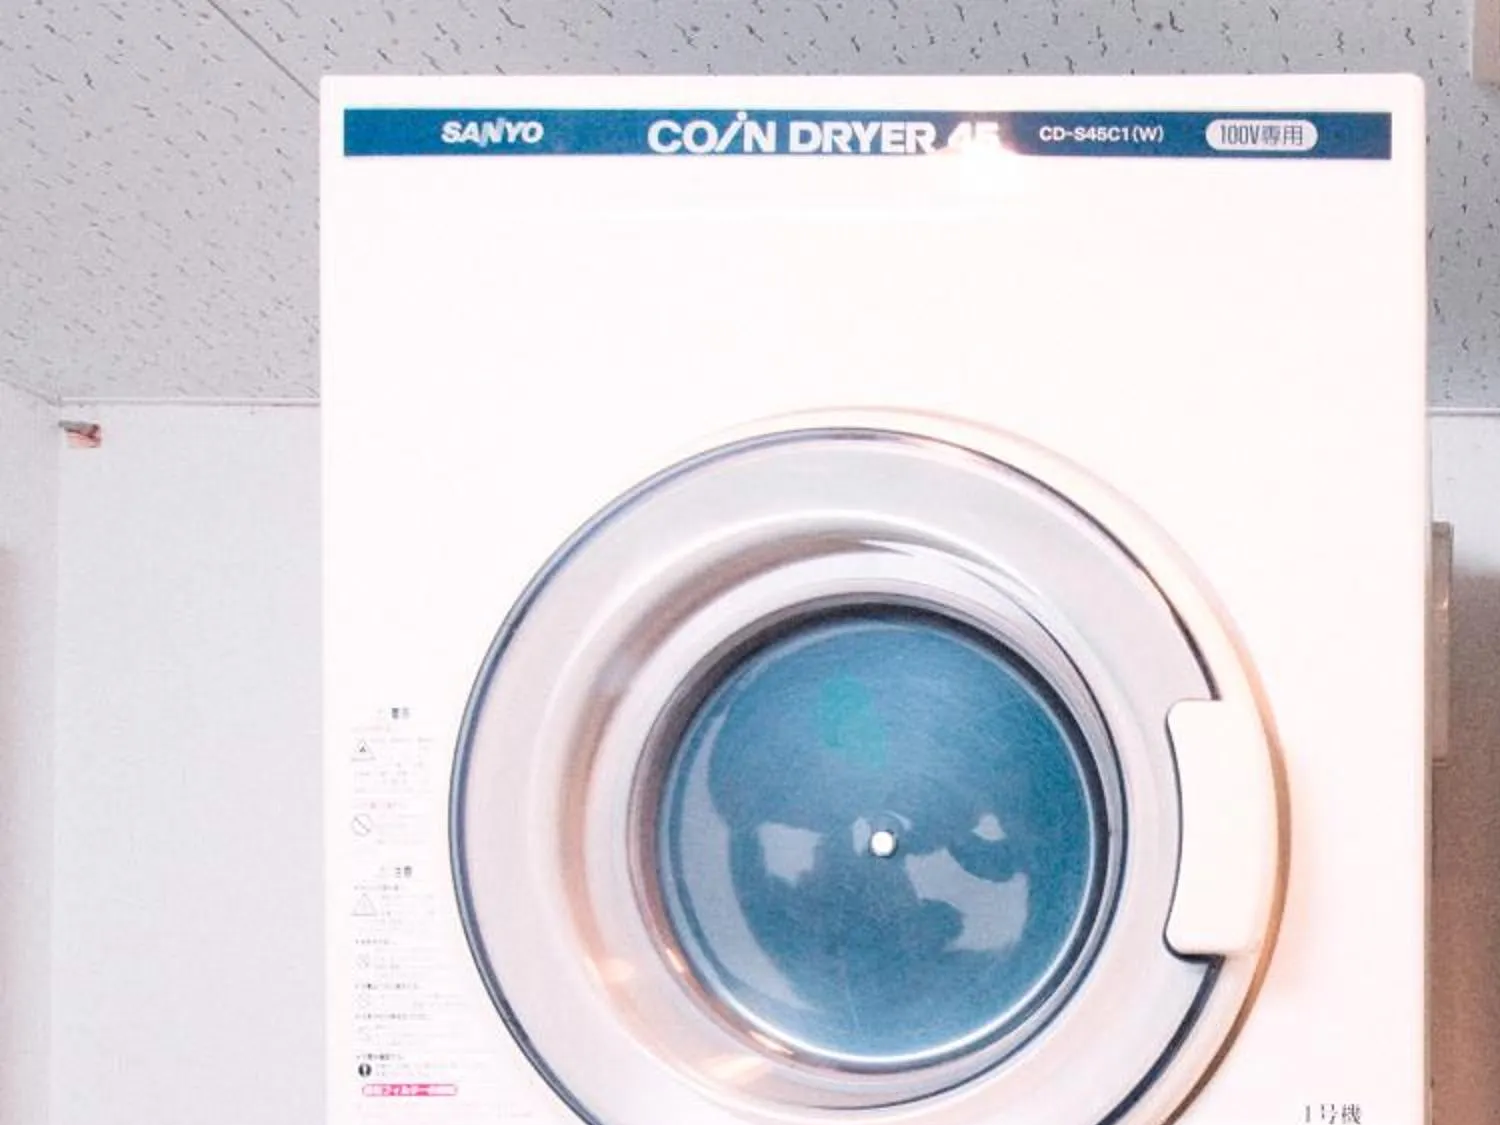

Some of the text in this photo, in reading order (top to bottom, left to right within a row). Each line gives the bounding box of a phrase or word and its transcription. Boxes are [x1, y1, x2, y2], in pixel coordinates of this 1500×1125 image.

[441, 119, 544, 146] SANYO
[790, 121, 937, 153] DRYER
[1038, 125, 1165, 146] CD-S45C1(W)
[1219, 123, 1304, 146] 100V専用
